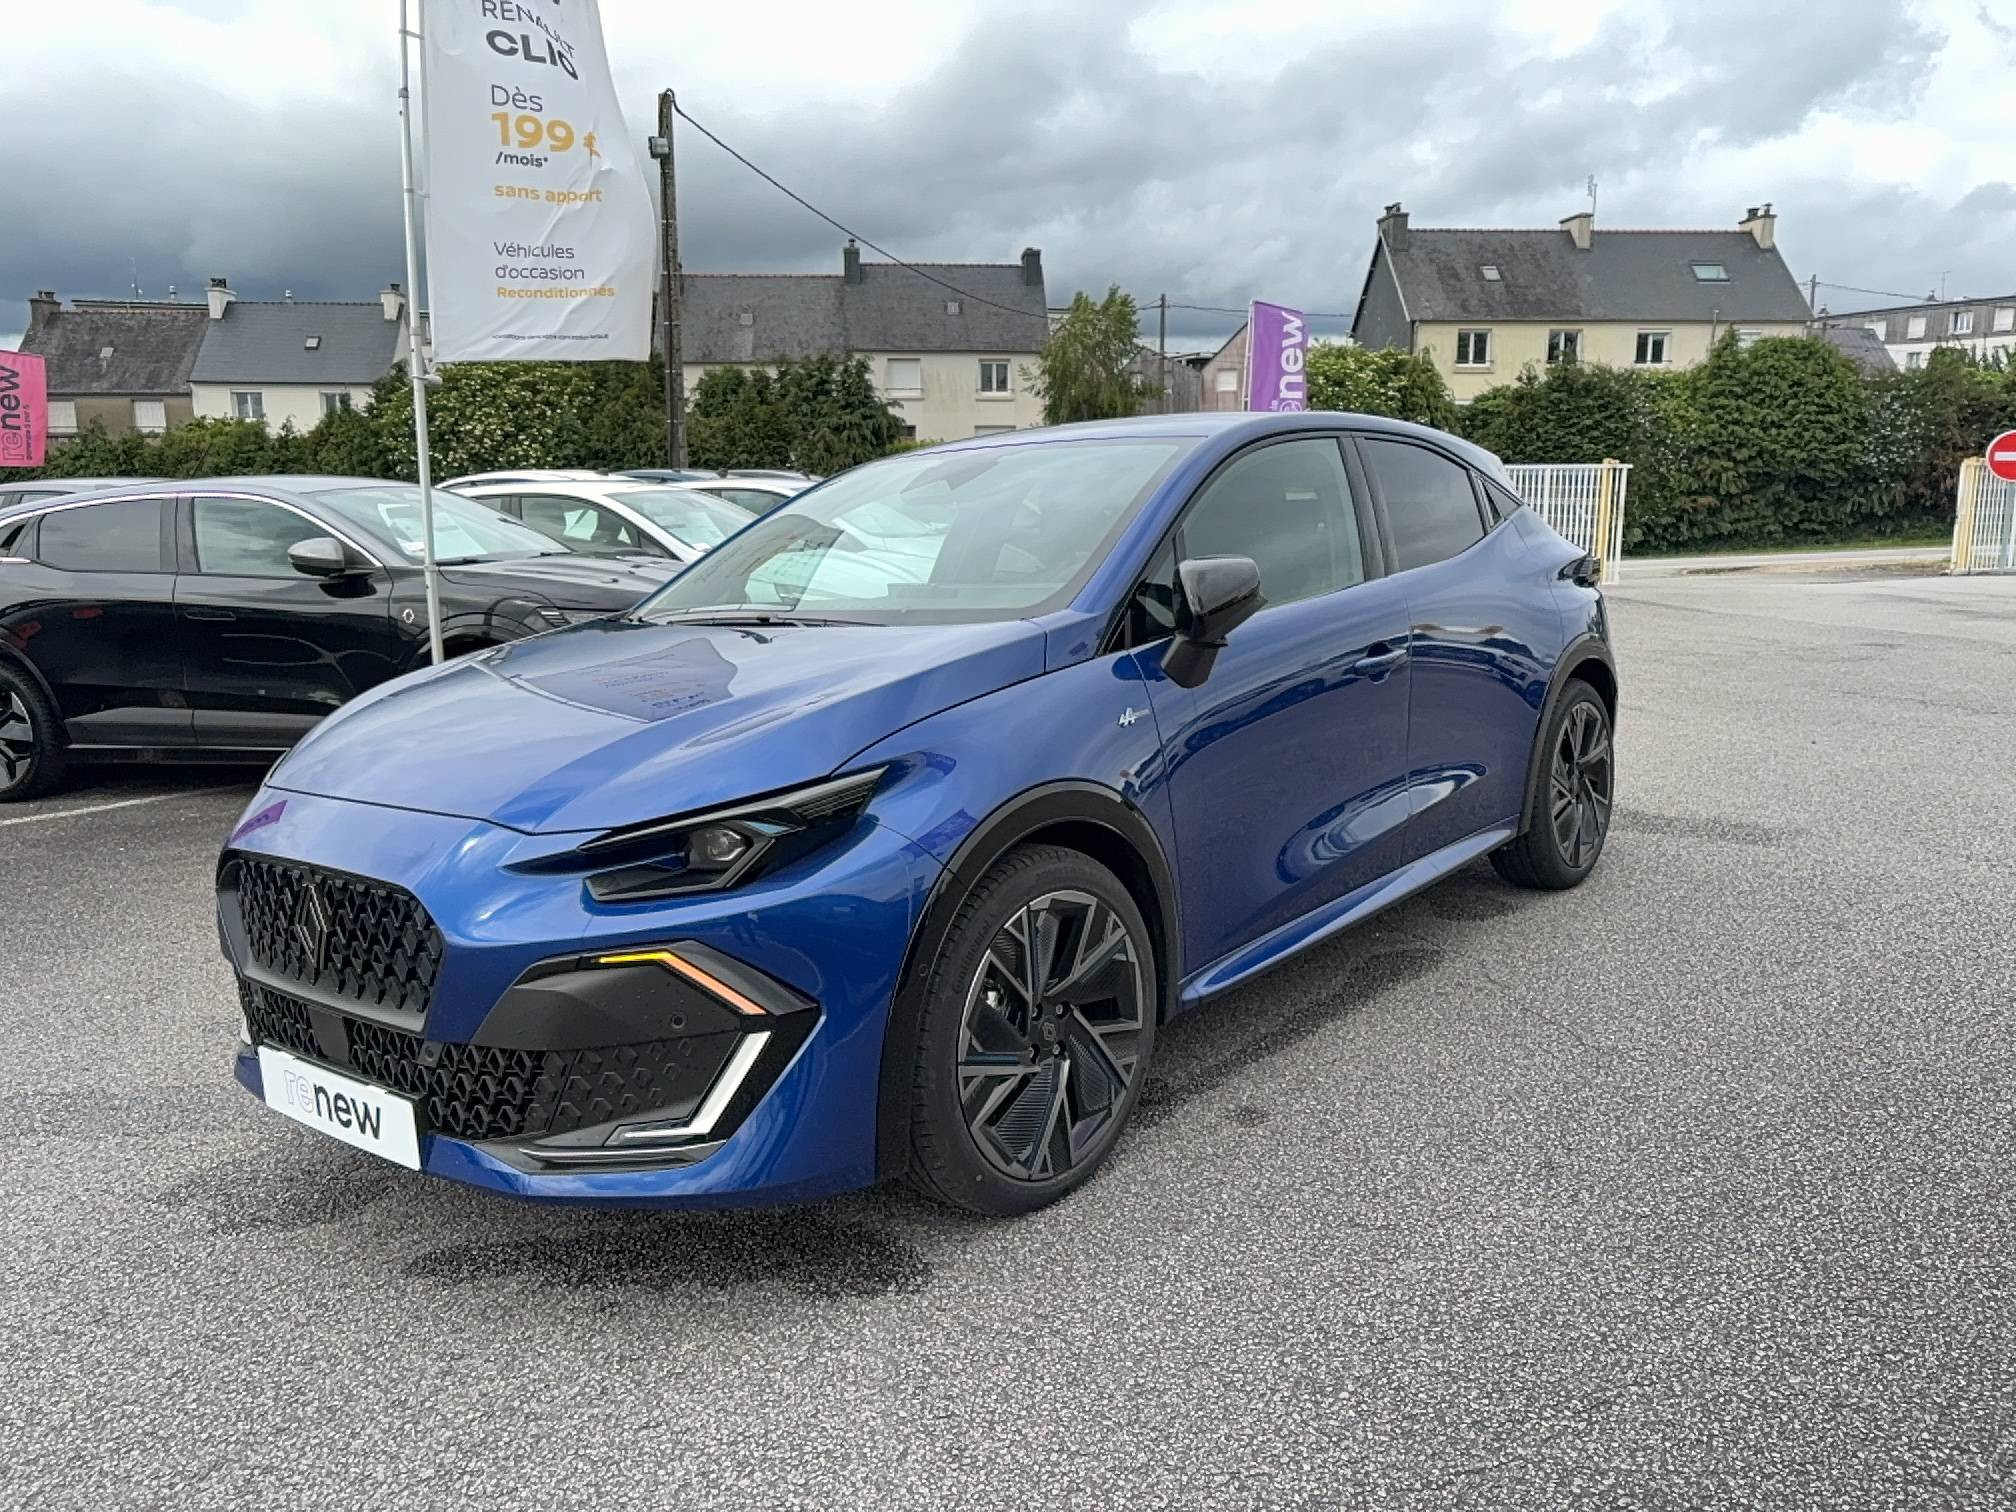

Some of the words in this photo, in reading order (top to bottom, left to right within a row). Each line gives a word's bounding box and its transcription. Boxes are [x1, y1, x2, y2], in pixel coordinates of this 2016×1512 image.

[486, 29, 579, 80] CLIO
[491, 84, 543, 112] Dès
[491, 112, 575, 153] 199
[494, 185, 540, 201] sans
[545, 187, 603, 204] apport
[494, 241, 575, 260] Véhicules
[495, 264, 585, 281] d'occasion
[497, 284, 615, 299] Reconditionnés
[0, 366, 24, 461] renew
[284, 1069, 381, 1141] renew
